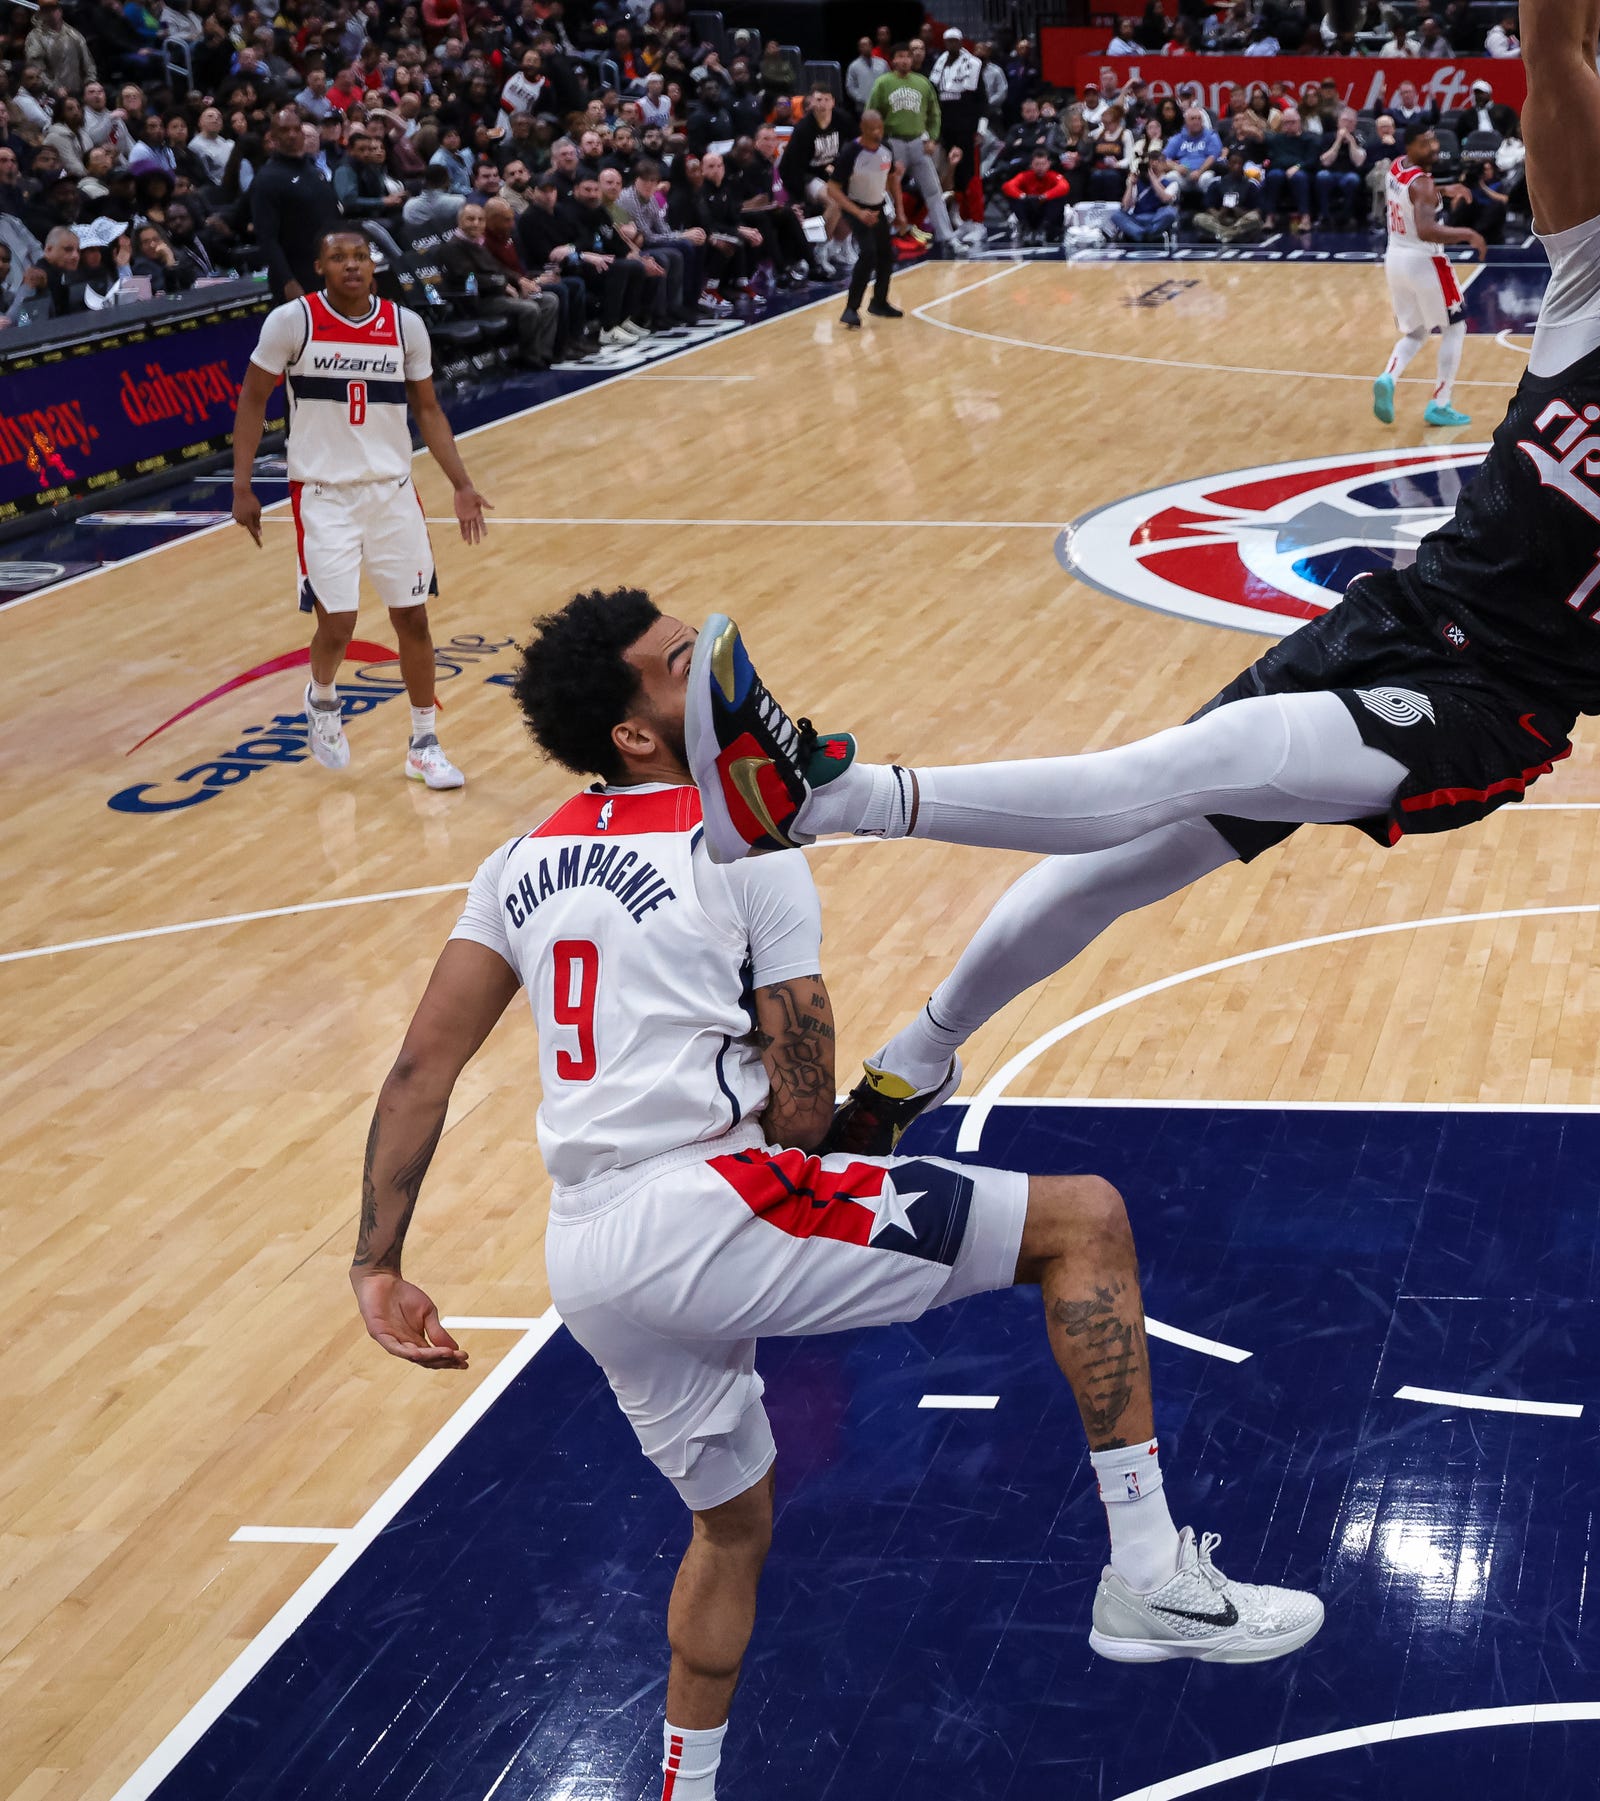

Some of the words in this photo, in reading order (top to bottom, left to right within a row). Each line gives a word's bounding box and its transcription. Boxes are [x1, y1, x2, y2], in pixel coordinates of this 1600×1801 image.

[314, 352, 399, 375] wizards
[347, 380, 367, 427] 8
[505, 843, 677, 929] CHAMPAGNIE
[552, 939, 600, 1082] 9
